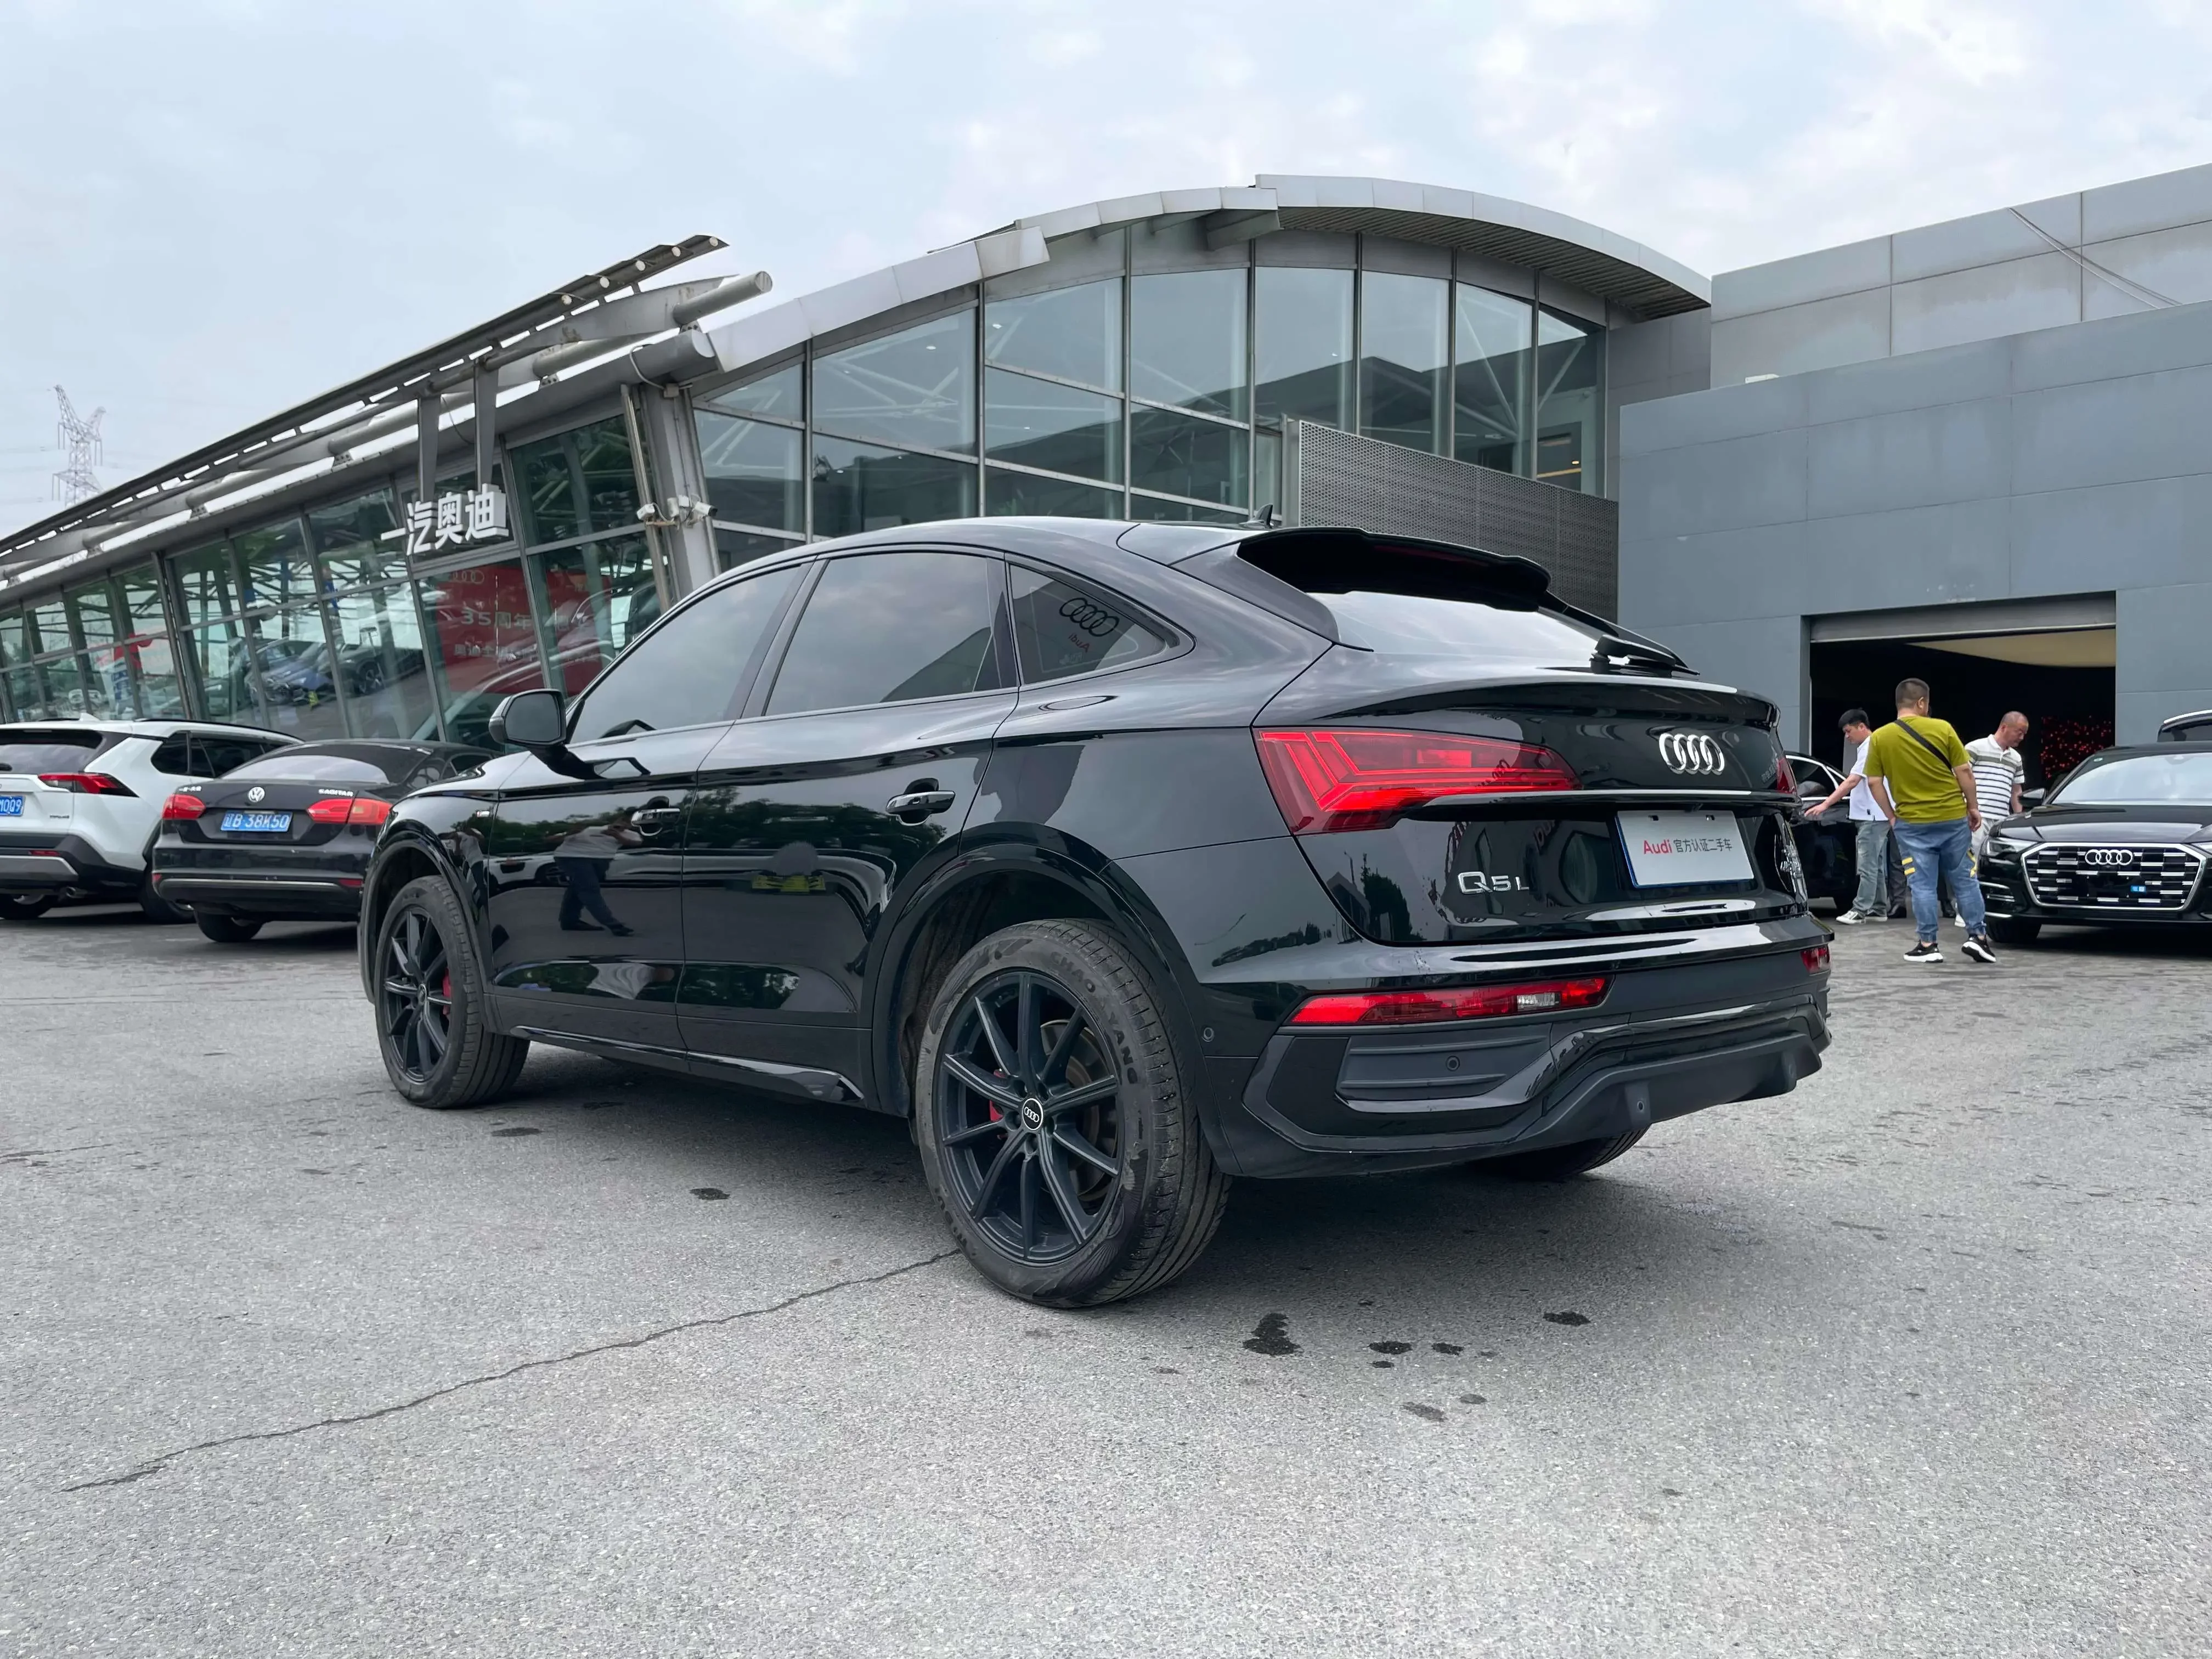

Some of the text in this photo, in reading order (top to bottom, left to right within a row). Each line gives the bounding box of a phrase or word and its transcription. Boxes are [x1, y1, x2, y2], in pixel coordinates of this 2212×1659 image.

[381, 483, 509, 555] 一汽奥迪
[1644, 838, 1733, 854] Audi 官方认证二手车
[1050, 952, 1096, 993] CHAO
